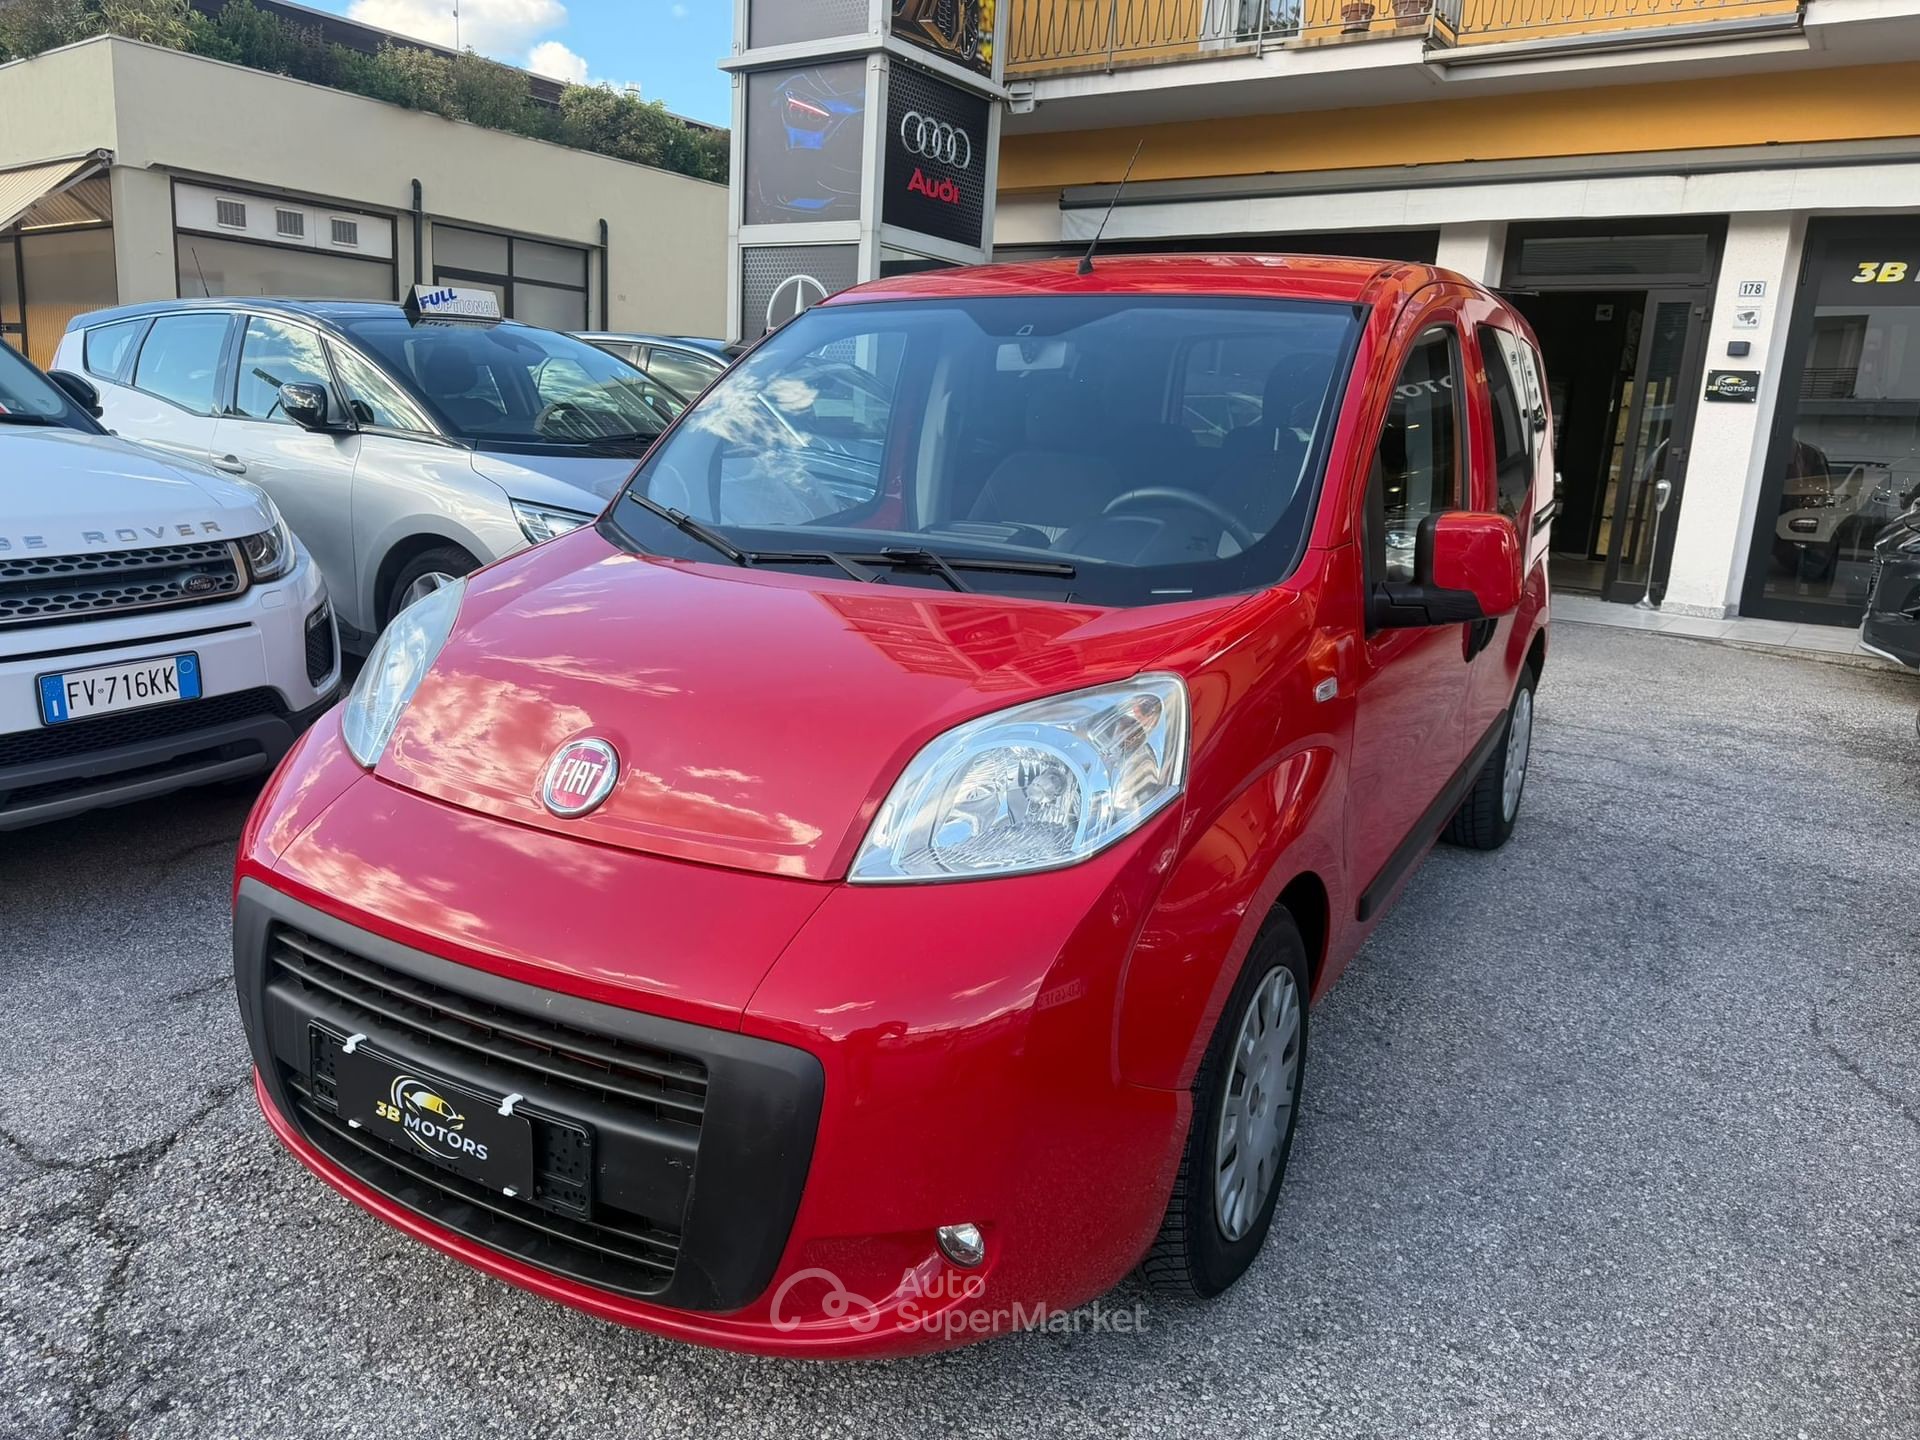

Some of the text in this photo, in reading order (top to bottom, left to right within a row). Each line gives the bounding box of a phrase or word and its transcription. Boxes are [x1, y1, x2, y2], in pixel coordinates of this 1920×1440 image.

[907, 167, 960, 204] Audi
[1851, 261, 1908, 283] 3B
[419, 288, 457, 309] FULL
[1743, 283, 1762, 295] 178
[1720, 384, 1756, 392] MOTORS
[81, 521, 222, 544] ROVER
[556, 758, 603, 796] FIAT
[375, 1100, 488, 1161] 3B MOTORS
